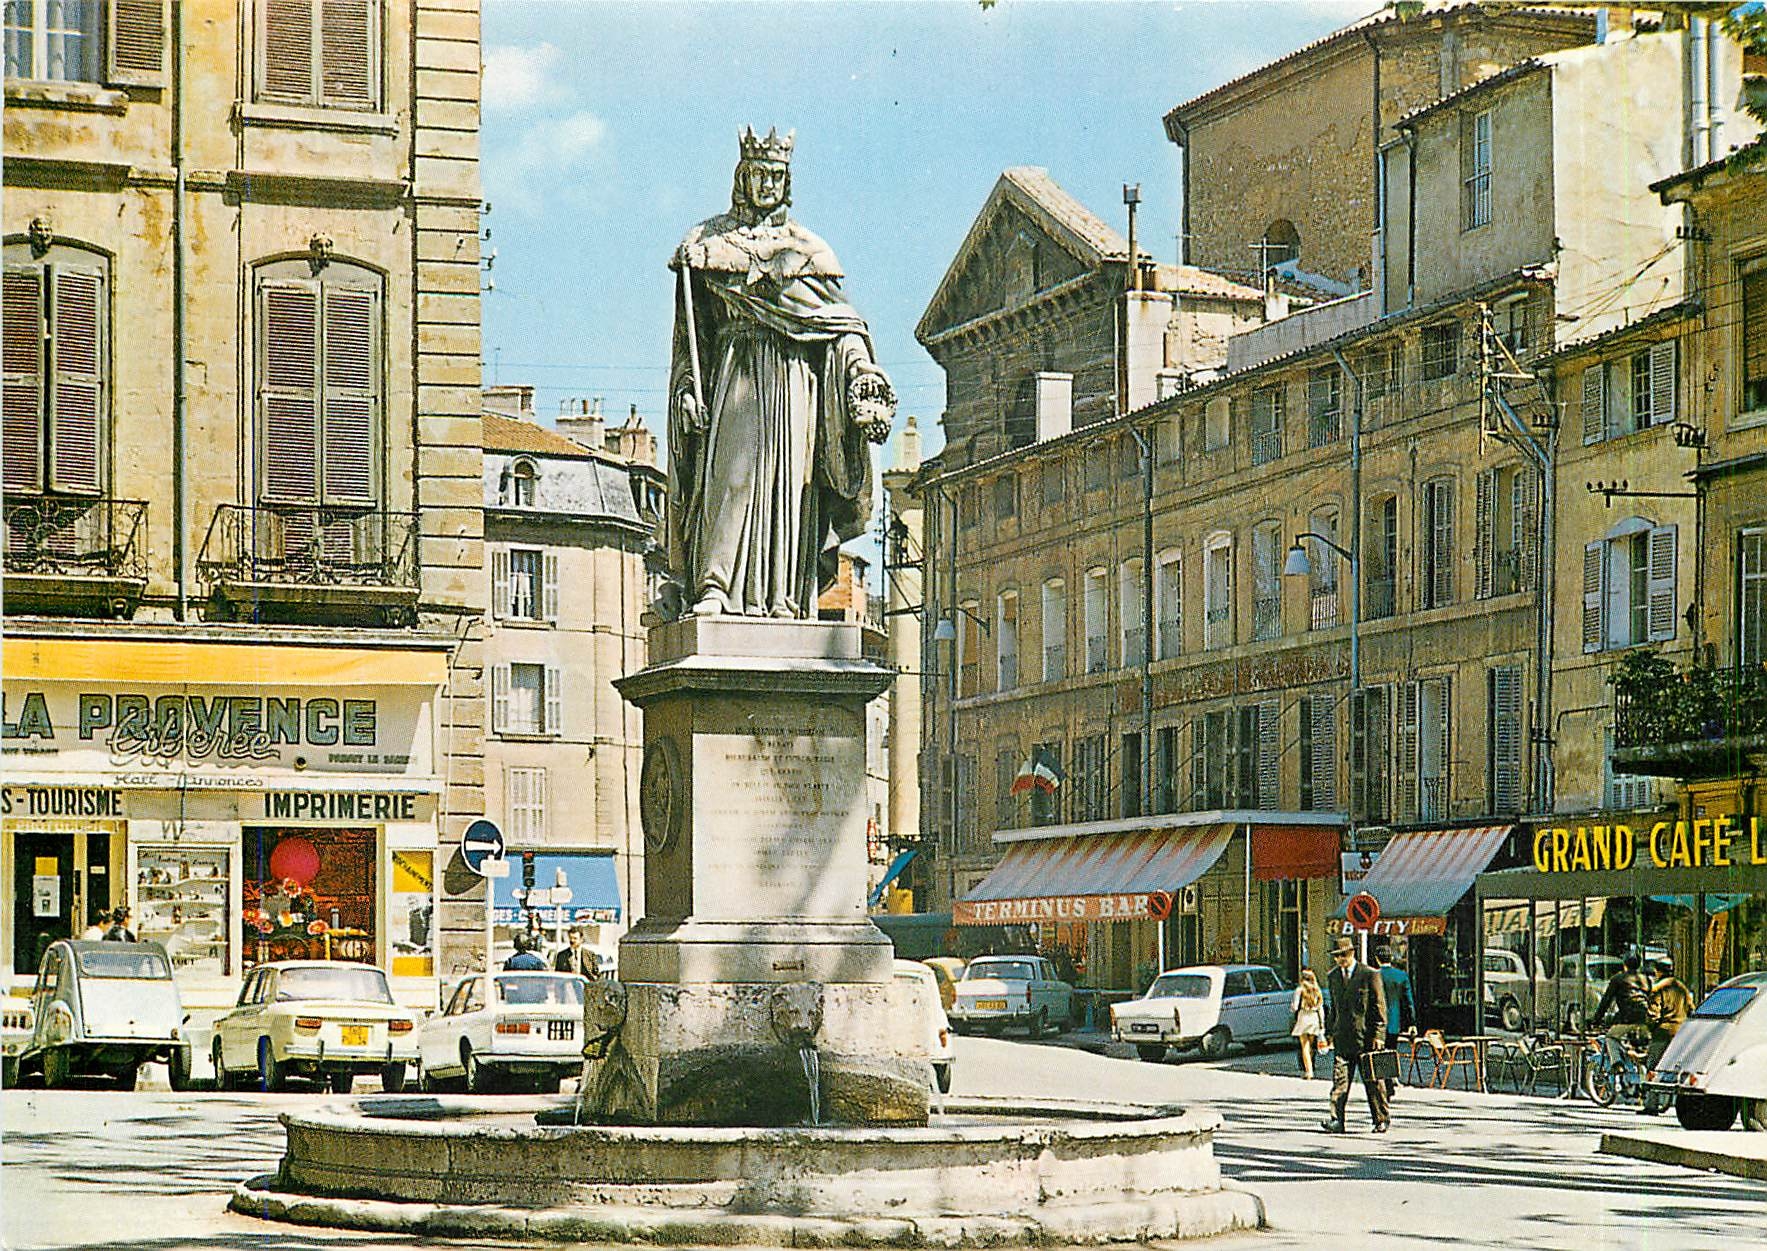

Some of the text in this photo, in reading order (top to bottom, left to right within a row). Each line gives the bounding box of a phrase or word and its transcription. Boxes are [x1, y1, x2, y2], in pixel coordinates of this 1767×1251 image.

[2, 692, 377, 746] LA PROVENCE
[265, 793, 416, 819] IMPRIMERIE
[1533, 824, 1635, 873] GRAND
[1651, 813, 1732, 868] CAFÉ
[973, 894, 1149, 920] TERMINUS BAR
